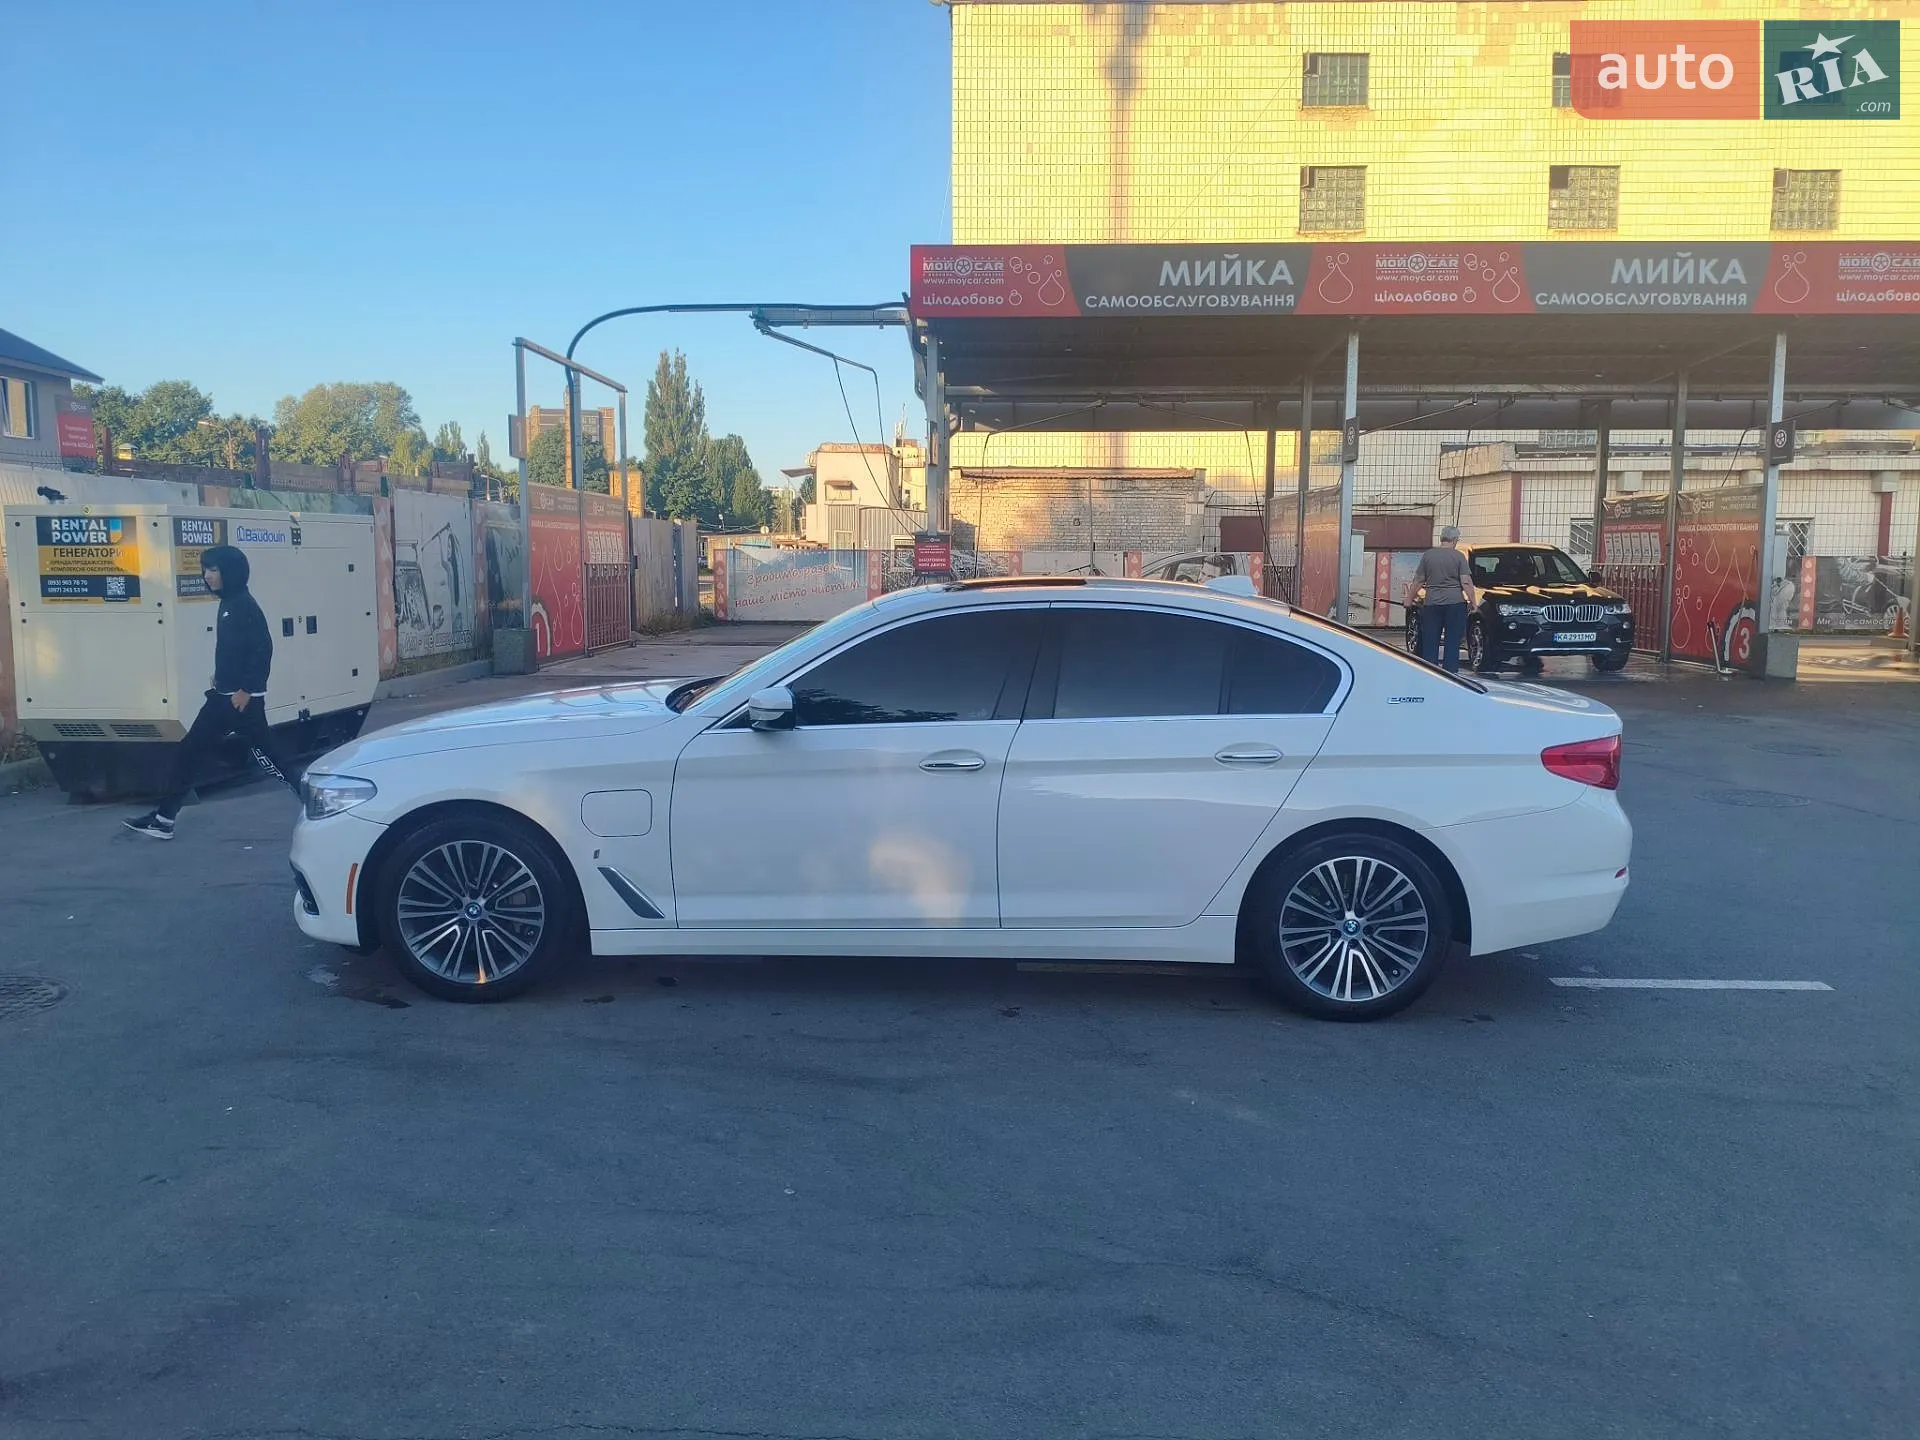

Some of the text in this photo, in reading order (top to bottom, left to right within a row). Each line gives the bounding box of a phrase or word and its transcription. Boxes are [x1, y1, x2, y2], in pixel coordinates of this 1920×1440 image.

[974, 262, 1005, 271] CAR
[1159, 253, 1294, 287] МИЙКА
[1428, 259, 1460, 268] CAR
[1610, 251, 1747, 284] МИЙКА
[922, 276, 1005, 286] www.moycar.com
[1375, 273, 1460, 283] www.moycar.com
[922, 293, 1005, 306] цілодобово
[1085, 293, 1295, 309] САМООБСЛУГОВУВАННЯ
[1374, 290, 1458, 303] цілодобово
[1534, 292, 1748, 307] САМООБСЛУГОВУВАННЯ
[1836, 289, 1920, 303] цілодобово
[51, 519, 107, 531] RENTAL
[181, 520, 213, 532] RENTAL
[52, 532, 108, 544] POWER
[182, 532, 213, 544] POWER
[246, 528, 286, 543] Baudouin
[747, 569, 798, 588] Зробимо
[735, 597, 765, 609] наше
[770, 587, 807, 603] місто
[1738, 627, 1751, 660] 3
